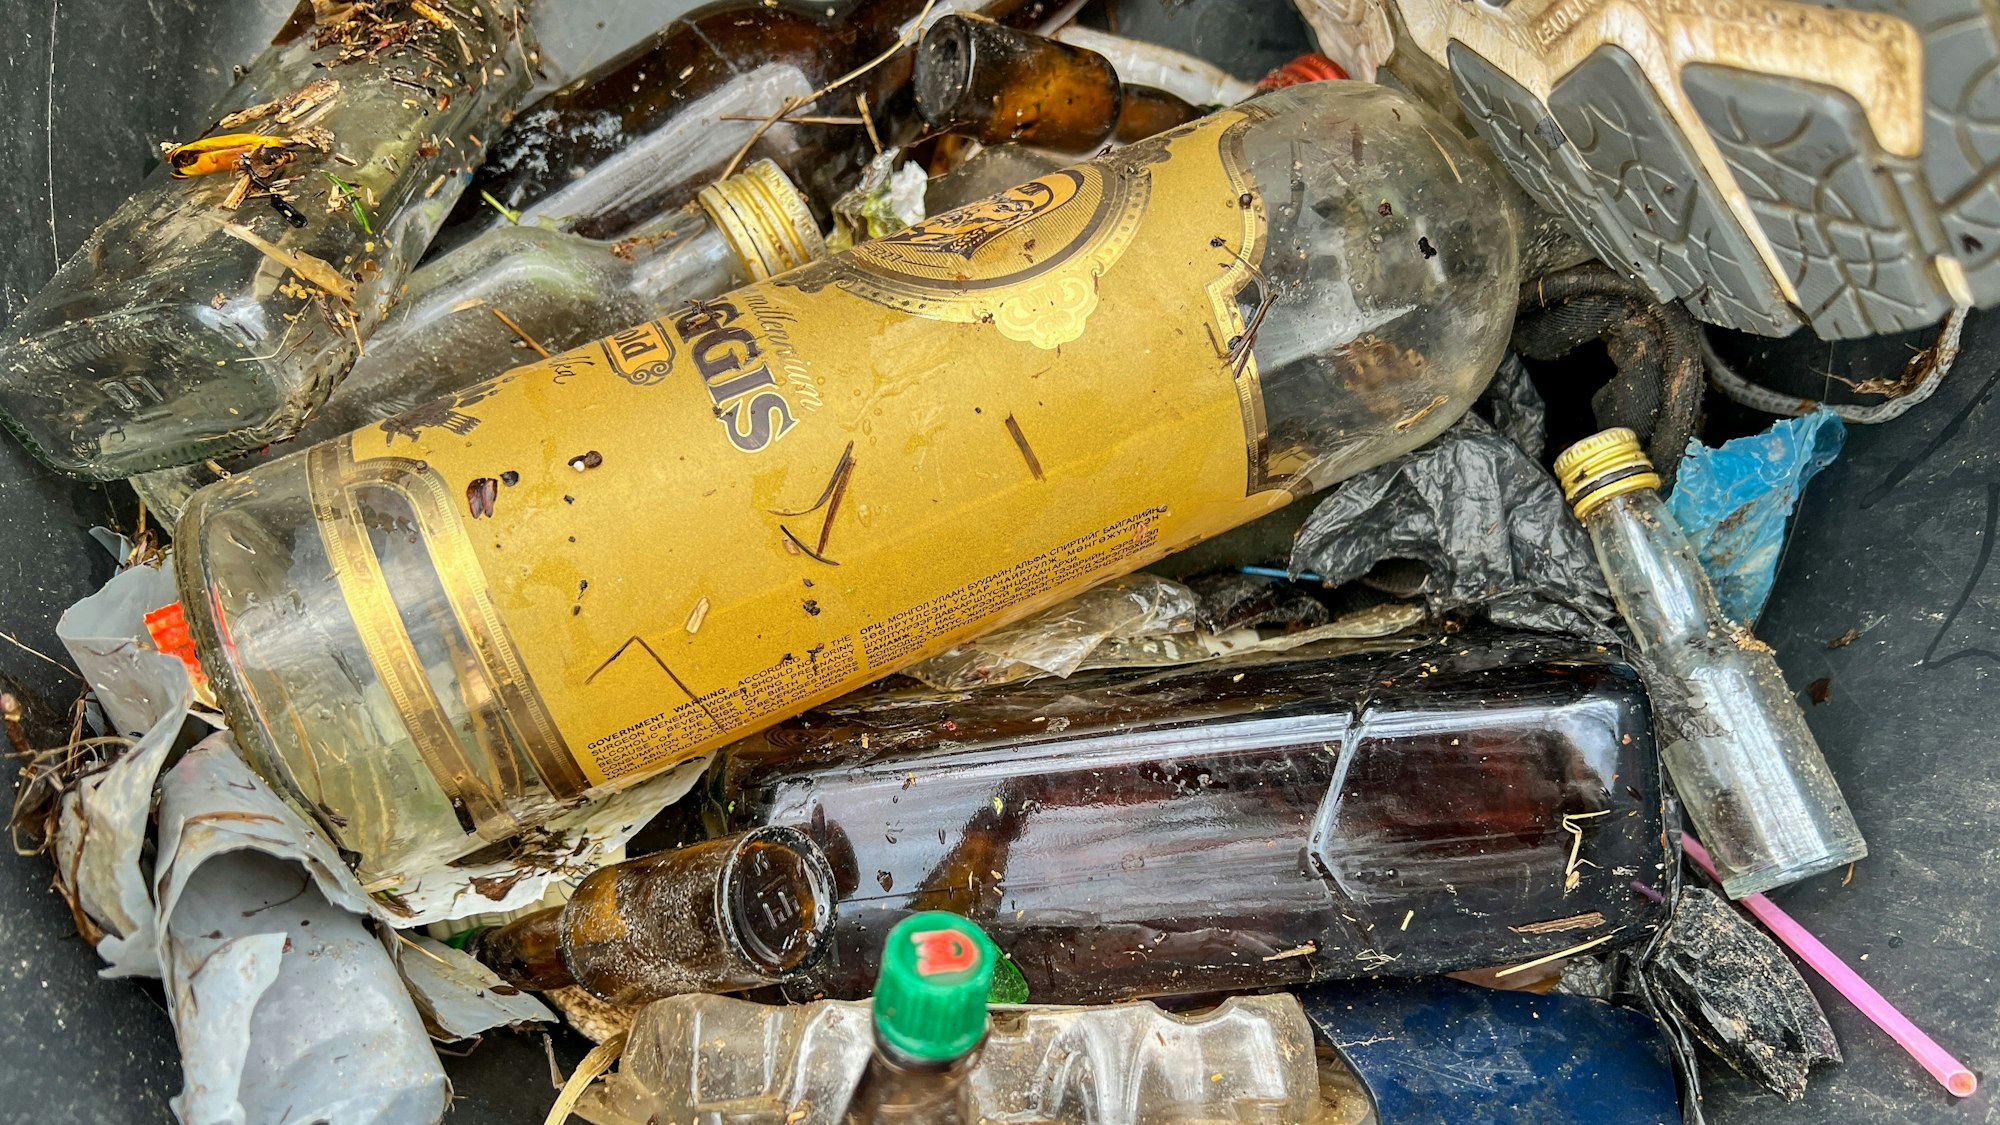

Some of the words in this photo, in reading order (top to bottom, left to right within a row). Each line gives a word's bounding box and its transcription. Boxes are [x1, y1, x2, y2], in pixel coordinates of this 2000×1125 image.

[859, 620, 885, 635] ОРЦ:
[886, 601, 930, 624] МОНГОЛ
[931, 586, 965, 605] УЛААН
[966, 566, 1012, 591] БУУДАЙН
[1013, 552, 1047, 570] АЛЬФА
[1048, 528, 1101, 556] СПИРТИЙГ
[1102, 504, 1161, 534] БАЙГАЛИЙН
[864, 631, 913, 655] САНАМЖ:
[918, 624, 929, 633] 21
[934, 613, 956, 626] НАС
[1013, 574, 1048, 593] БОЛОН
[1053, 550, 1105, 575] ТЭЭВРИЙН
[1108, 527, 1159, 552] ХЭРЭЭЛ
[865, 632, 923, 660] ЖОЛООДОХ
[966, 591, 1023, 618] ЖИРЭМСЭН
[1092, 533, 1159, 565] ХЭРЭГЛЭХИЙГ
[932, 598, 973, 620] ДАВХАР
[972, 582, 1013, 603] ШҮҮСЭН
[1012, 566, 1051, 587] ЦАГААН
[951, 583, 991, 604] УСААР
[988, 591, 1037, 615] ХЭРЭГЛЭХ
[586, 711, 666, 750] GOVERNMENT
[672, 685, 730, 713] WARNING:
[736, 654, 801, 687] ACCORDING
[830, 633, 852, 647] THE
[590, 729, 645, 757] SURGEON
[648, 705, 703, 732] GENERAL,
[750, 666, 793, 689] SHOULD
[796, 656, 817, 669] NO
[821, 641, 854, 659] DRINK
[594, 731, 659, 763] ALCOHOLIC
[665, 700, 733, 732] BEVERAGES
[740, 678, 783, 701] DURING
[789, 648, 856, 680] PREGNANCY
[597, 742, 650, 768] BECAUSE
[658, 732, 673, 742] OF
[682, 719, 704, 732] THE
[712, 705, 738, 720] RISK
[744, 695, 759, 706] OF
[767, 679, 798, 697] BIRTH
[600, 736, 679, 773] CONSUMPTION
[696, 704, 756, 733] ALCOHOLIC
[756, 677, 817, 708] BEVERAGES
[818, 660, 858, 680] IMPAIRS
[603, 761, 635, 778] YOUR
[641, 742, 680, 761] ABILITY
[709, 716, 742, 733] DRIVE
[813, 666, 860, 688] OPERATE
[715, 717, 750, 735] CAUSE
[751, 700, 790, 720] HEALTH
